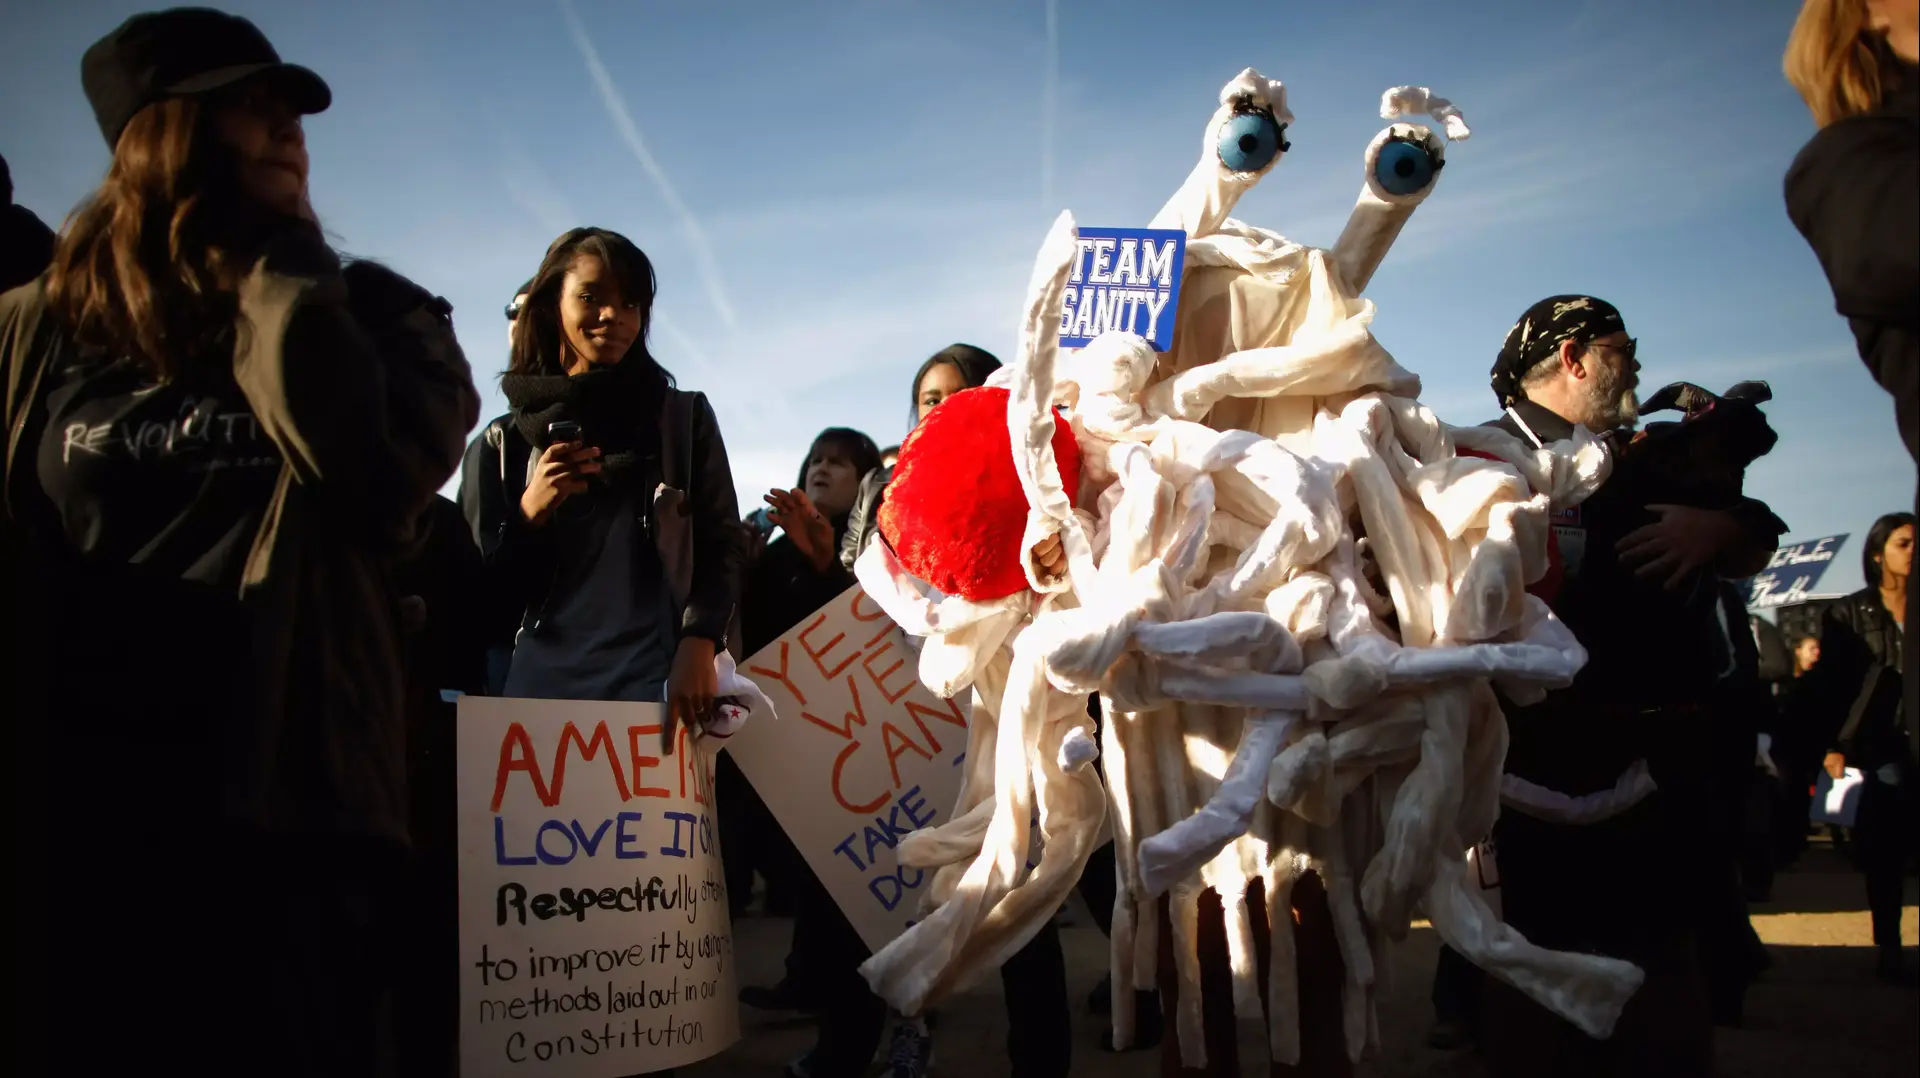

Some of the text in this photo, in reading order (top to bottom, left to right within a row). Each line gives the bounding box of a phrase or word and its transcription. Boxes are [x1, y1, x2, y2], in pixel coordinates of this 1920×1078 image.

[1070, 237, 1176, 288] TEAM
[1059, 285, 1171, 343] SANITY
[63, 412, 259, 469] REVOLUTI
[750, 588, 898, 706] YES
[801, 640, 917, 740] WE
[490, 720, 716, 812] AMER
[831, 696, 968, 814] CAN
[494, 811, 648, 866] LOVE
[660, 811, 698, 859] IT
[833, 784, 937, 872] TAKE
[496, 874, 698, 926] Respectfully
[475, 944, 518, 986] to
[529, 943, 645, 982] improve
[651, 934, 671, 964] it
[676, 930, 694, 970] by
[479, 975, 718, 1025] methods laid out in our
[505, 1013, 706, 1064] Constitution
